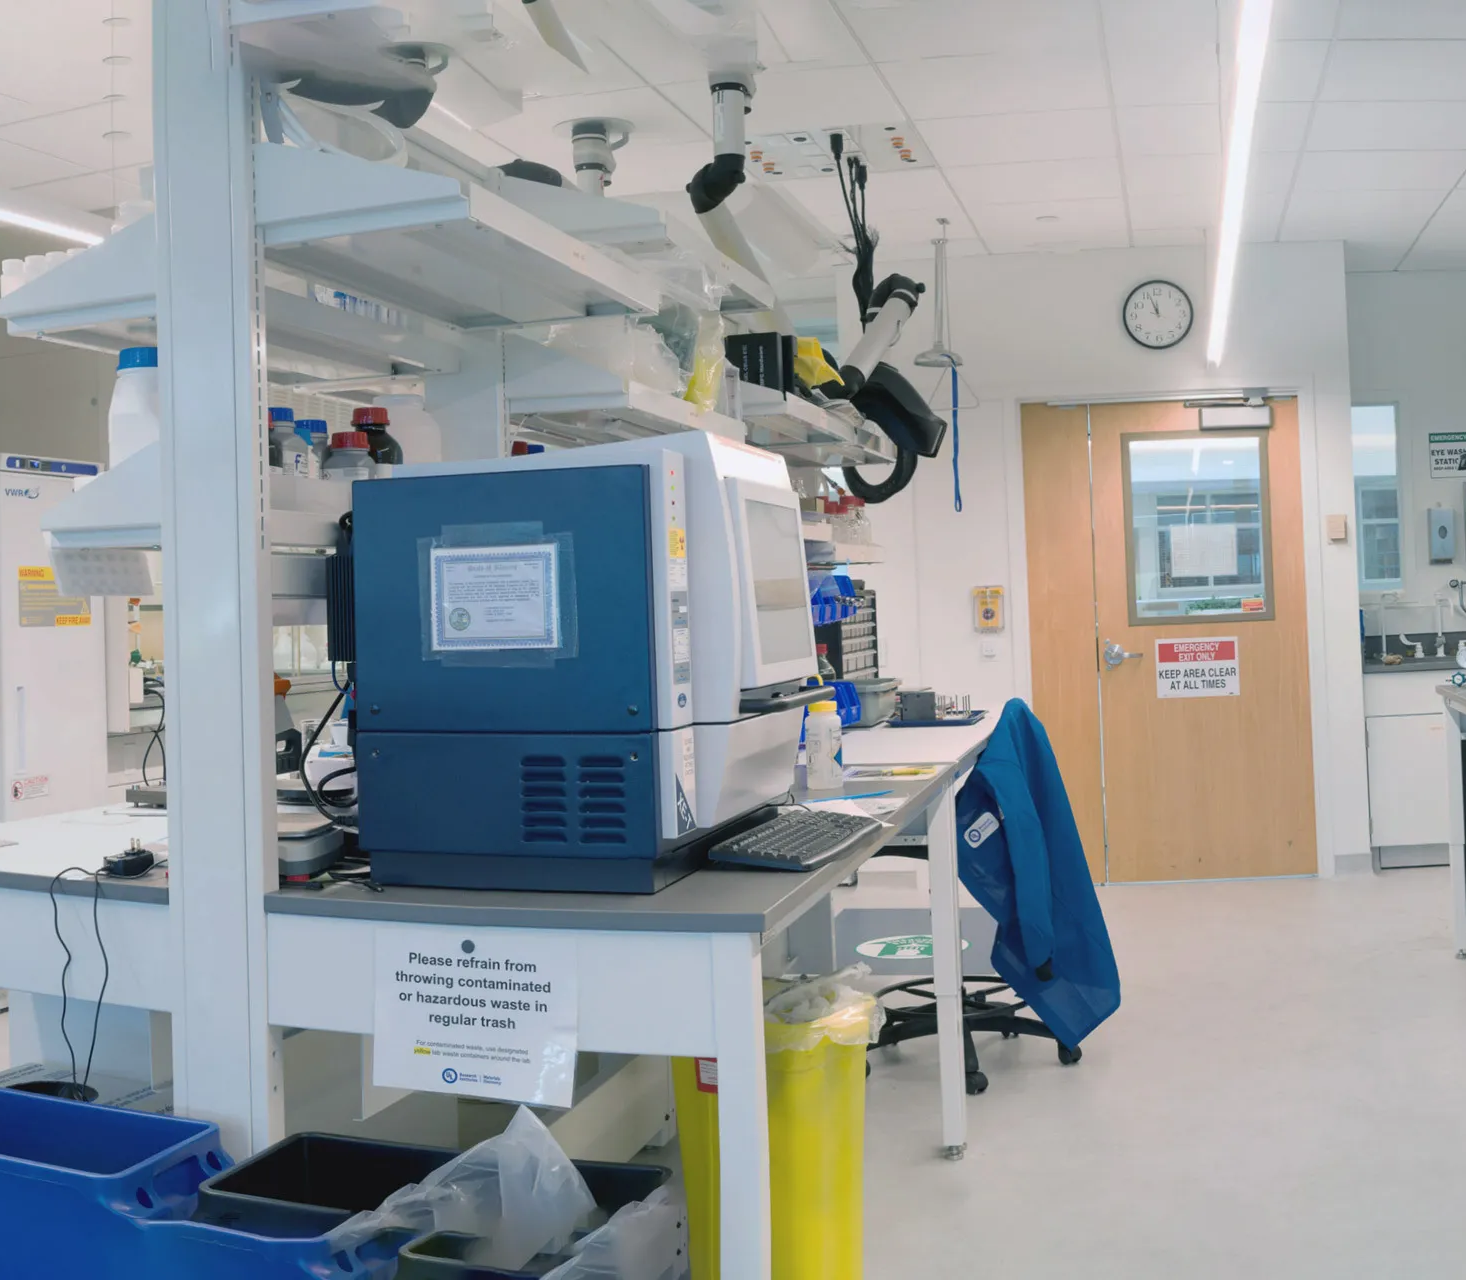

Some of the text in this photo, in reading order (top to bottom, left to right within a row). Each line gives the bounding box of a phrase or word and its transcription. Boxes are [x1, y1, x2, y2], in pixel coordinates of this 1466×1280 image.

[1431, 449, 1445, 457] EYE
[5, 488, 24, 498] VWR
[1174, 642, 1220, 653] EMERGENCY
[1178, 652, 1216, 662] EXIT ONLY
[1158, 666, 1237, 679] KEEP AREA CLEAR
[1170, 678, 1227, 690] AT ALL TIMES
[408, 952, 537, 973] Please refrain from
[395, 971, 551, 993] throwing contaminated
[398, 991, 548, 1012] or hazardous waste in
[429, 1013, 516, 1029] regular trash
[426, 1040, 465, 1050] contaminated
[497, 1046, 529, 1055] designated
[460, 1052, 490, 1060] containers
[490, 1054, 510, 1062] around
